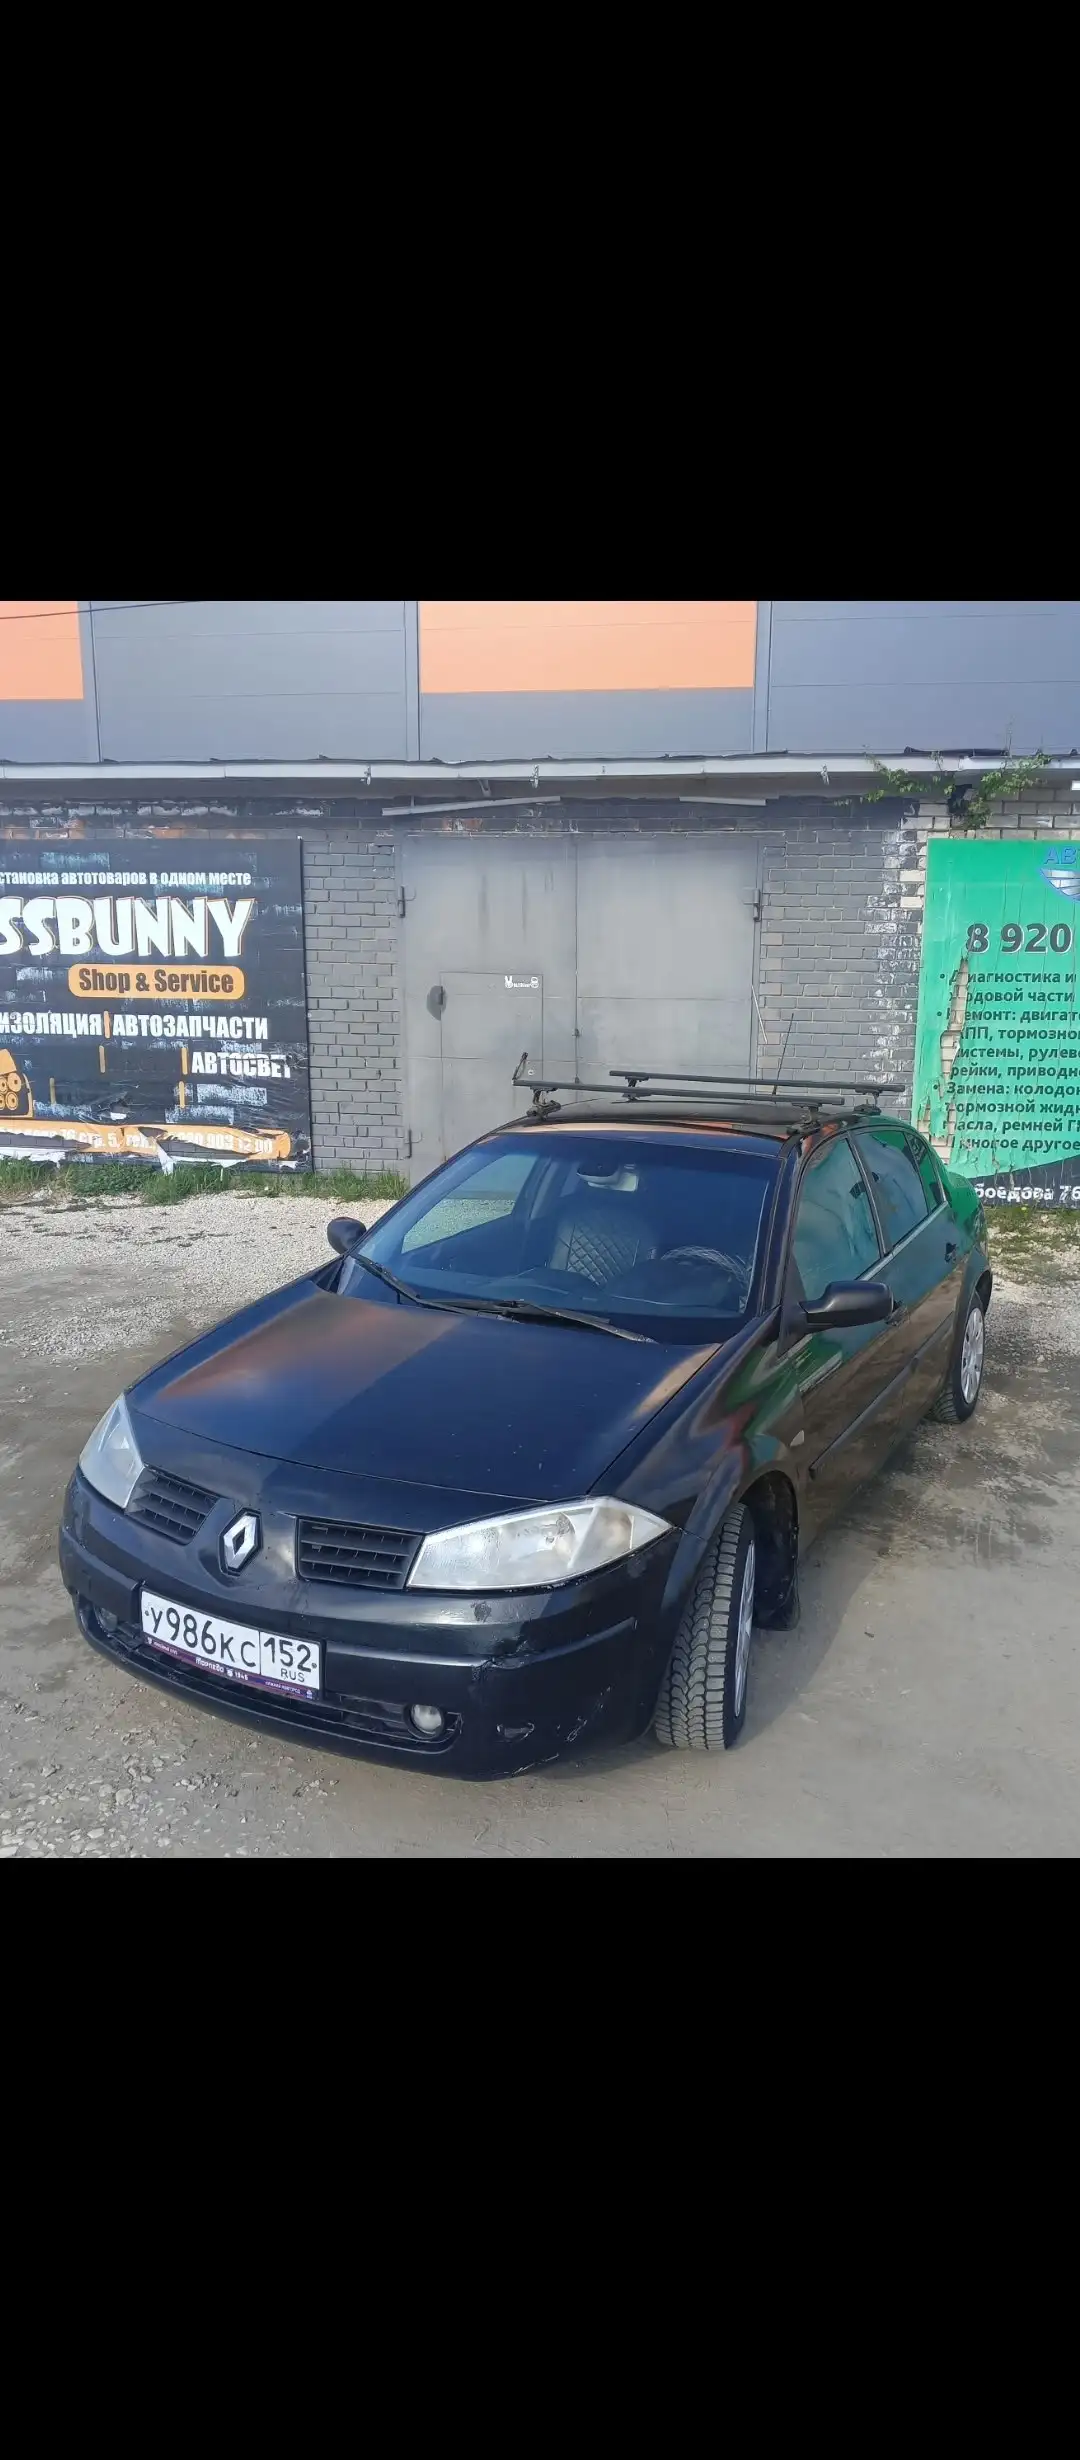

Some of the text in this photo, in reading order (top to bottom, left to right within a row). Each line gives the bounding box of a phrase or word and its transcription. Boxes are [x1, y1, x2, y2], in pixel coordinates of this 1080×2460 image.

[1043, 846, 1080, 865] АВ
[61, 872, 146, 886] автотоваров
[149, 873, 157, 885] в
[160, 873, 205, 886] одном
[208, 873, 251, 885] месте
[0, 896, 255, 957] SSBUNNY
[965, 923, 1072, 953] 8 920
[79, 967, 234, 994] Shop & Service
[1027, 992, 1075, 1003] части
[1020, 1011, 1080, 1024] двигат
[0, 1012, 268, 1039] ИЗОЛЯЦИЯ АВТОЗАПЧАСТИ
[998, 1029, 1080, 1043] тормозно
[956, 1047, 1080, 1062] истемы, рулев
[1007, 1066, 1080, 1080] приводн
[947, 1081, 1010, 1095] Замена:
[1002, 1118, 1063, 1134] ремней
[150, 1606, 312, 1673] У986КС 152
[280, 1668, 305, 1683] RUS
